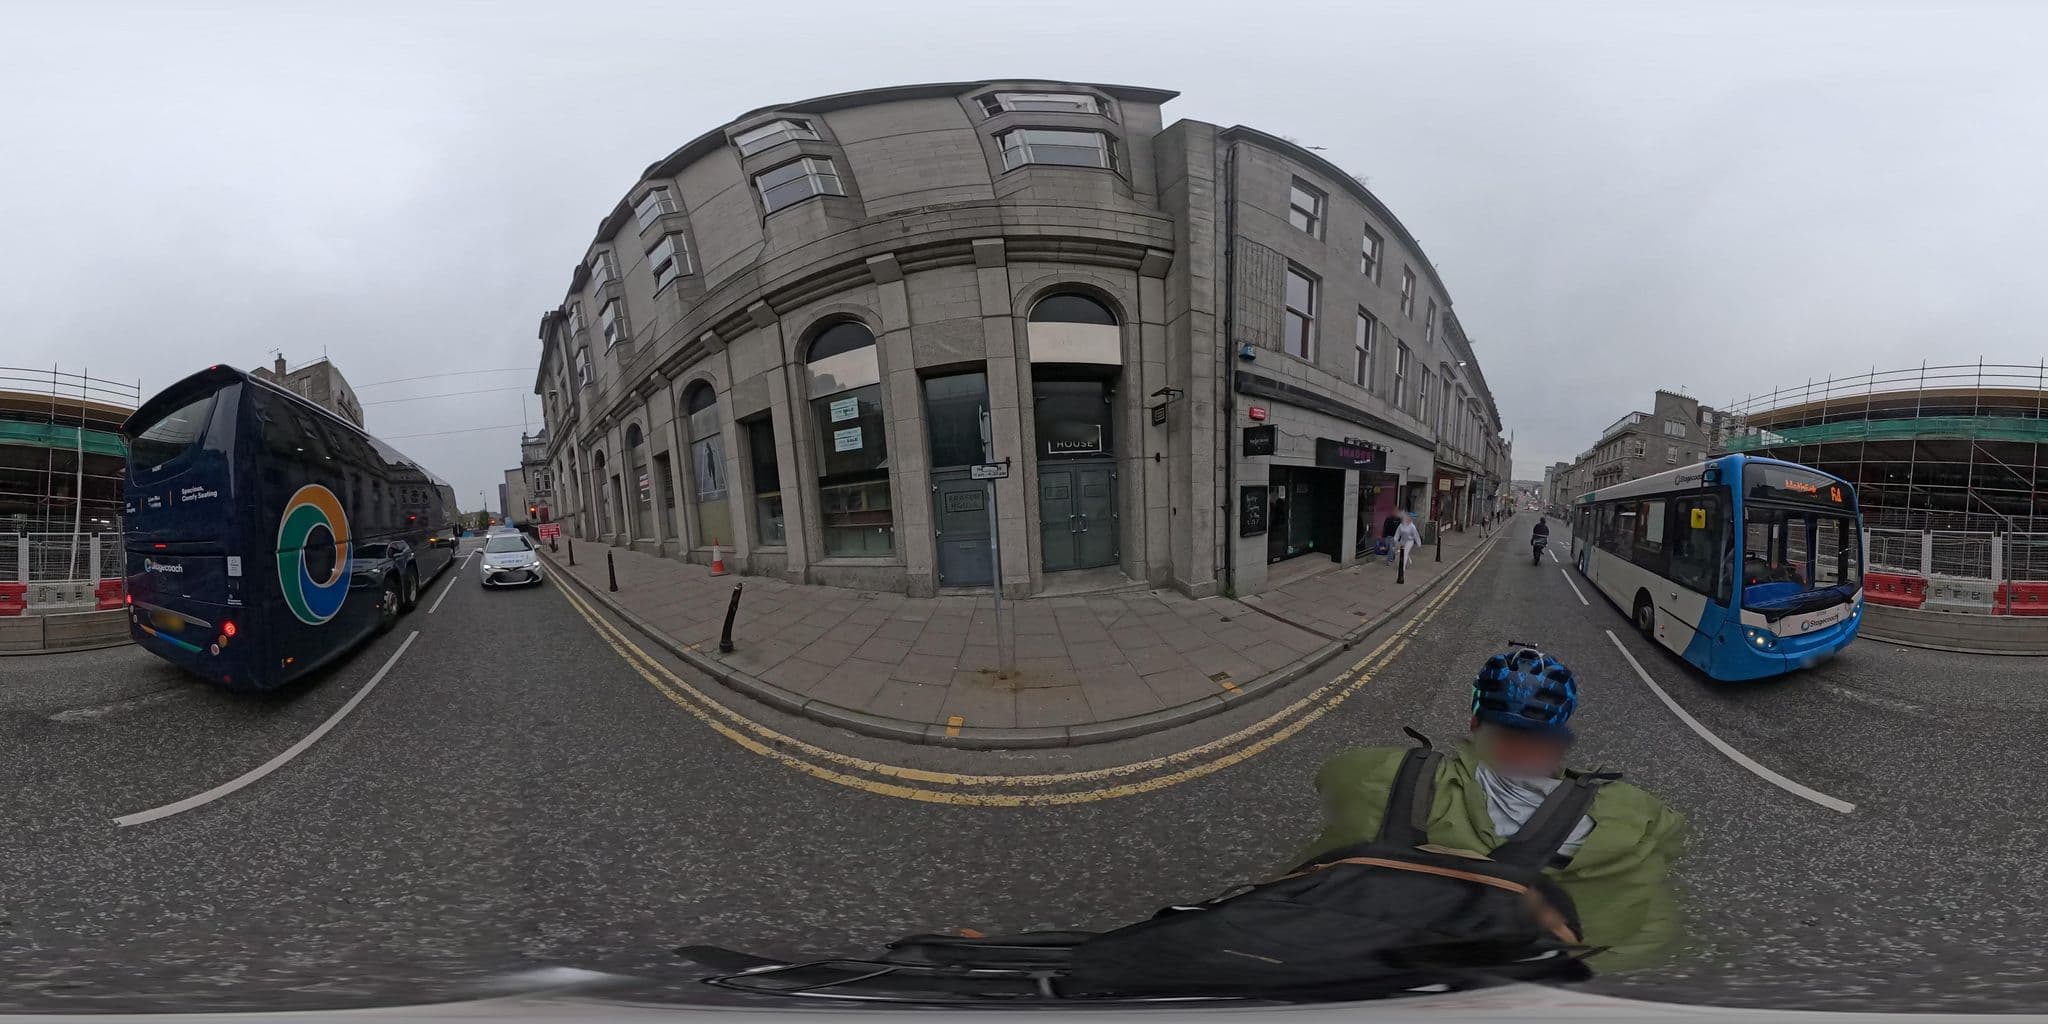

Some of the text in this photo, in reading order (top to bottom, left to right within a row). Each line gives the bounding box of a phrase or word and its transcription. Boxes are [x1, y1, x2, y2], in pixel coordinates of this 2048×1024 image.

[1057, 440, 1093, 449] HOUSE
[182, 491, 218, 502] Comfy Seating
